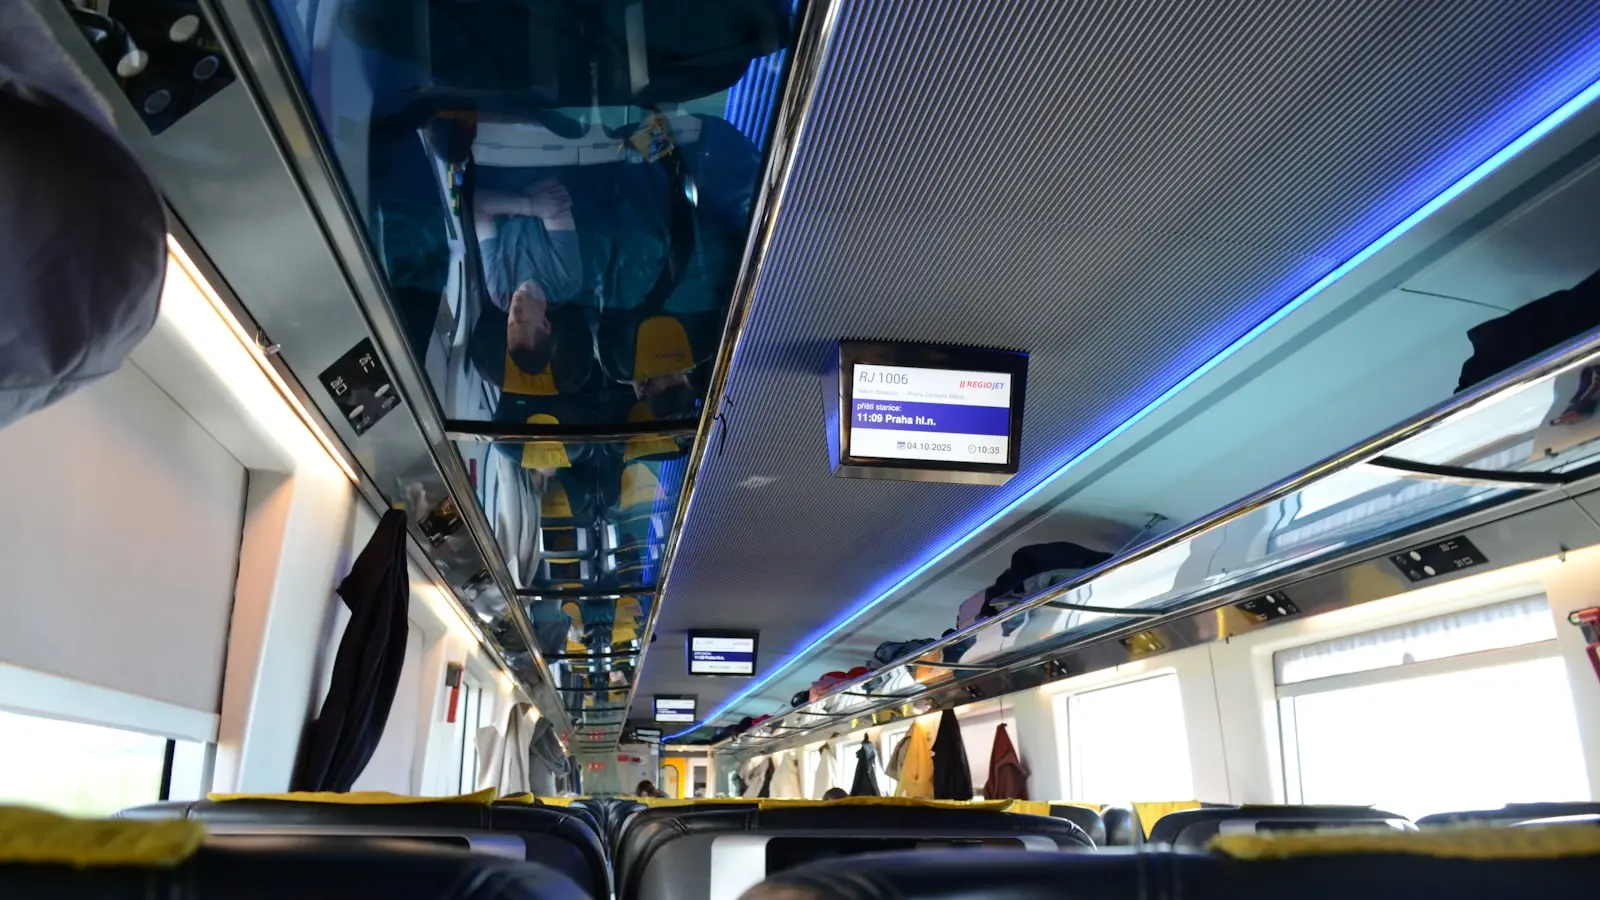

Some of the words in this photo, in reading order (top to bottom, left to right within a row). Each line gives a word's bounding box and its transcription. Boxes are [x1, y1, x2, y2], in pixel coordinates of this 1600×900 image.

[859, 371, 875, 383] RJ
[879, 372, 908, 385] 1006
[966, 380, 1005, 390] REGIOJET
[875, 403, 902, 412] stanice:
[857, 413, 883, 423] 11:09
[885, 414, 913, 425] Praha
[915, 416, 937, 426] hl.n.
[906, 441, 952, 452] 04.10.2025
[977, 445, 1000, 454] 10:35
